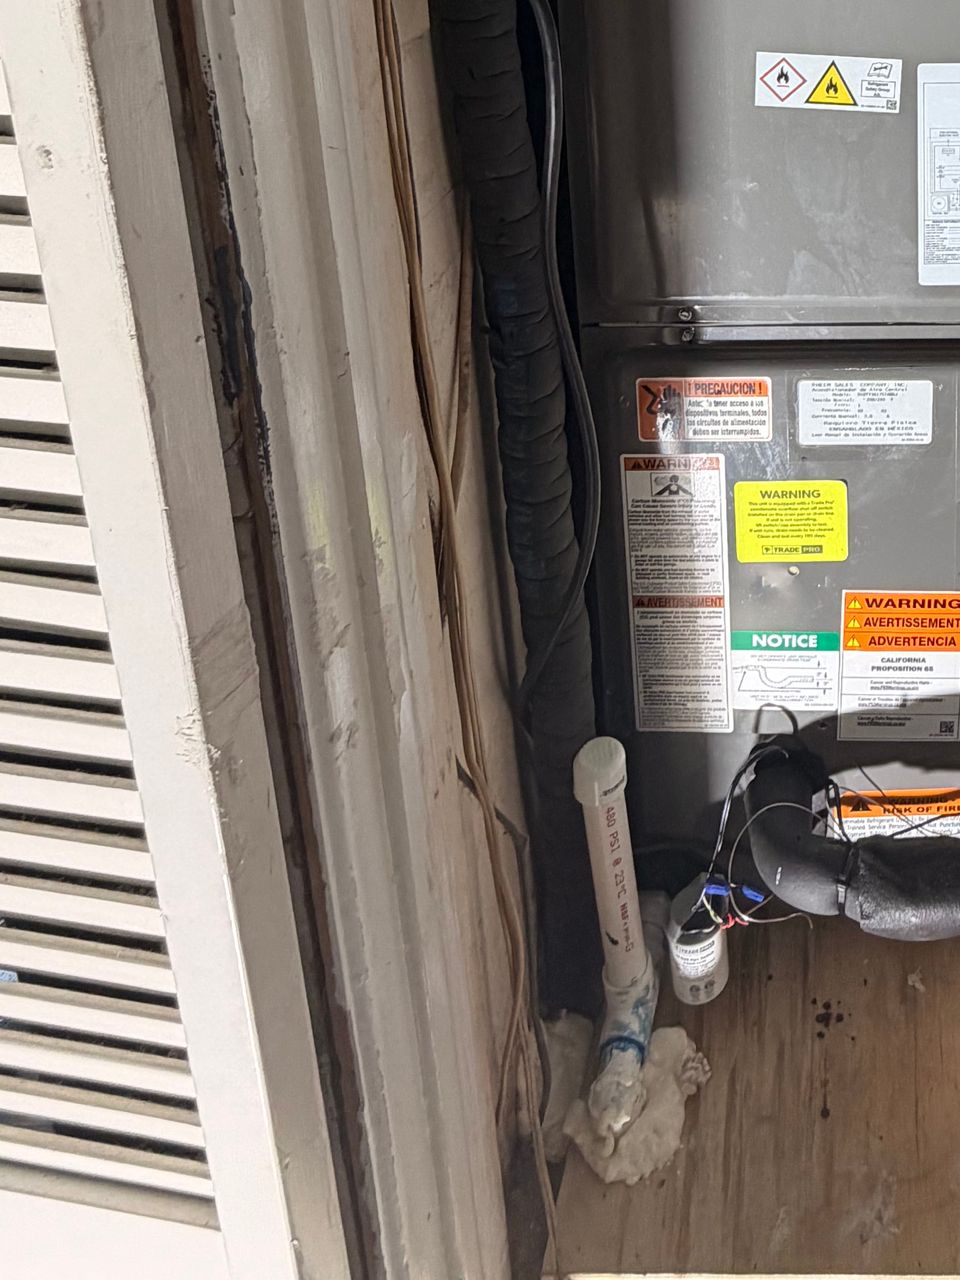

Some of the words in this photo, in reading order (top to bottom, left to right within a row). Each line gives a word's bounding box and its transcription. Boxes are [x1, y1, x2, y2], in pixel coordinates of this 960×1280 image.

[694, 382, 755, 395] PRECAUCION
[730, 400, 749, 408] acceso
[752, 410, 767, 418] todos
[711, 428, 719, 436] ser
[760, 489, 821, 499] WARNING
[648, 598, 723, 608] AVERTISSEMENT
[752, 634, 818, 648] NOTICE
[868, 636, 957, 647] ADVERTENCIA
[605, 806, 616, 828] 480
[609, 831, 621, 853] PSI
[614, 870, 628, 897] 23°C
